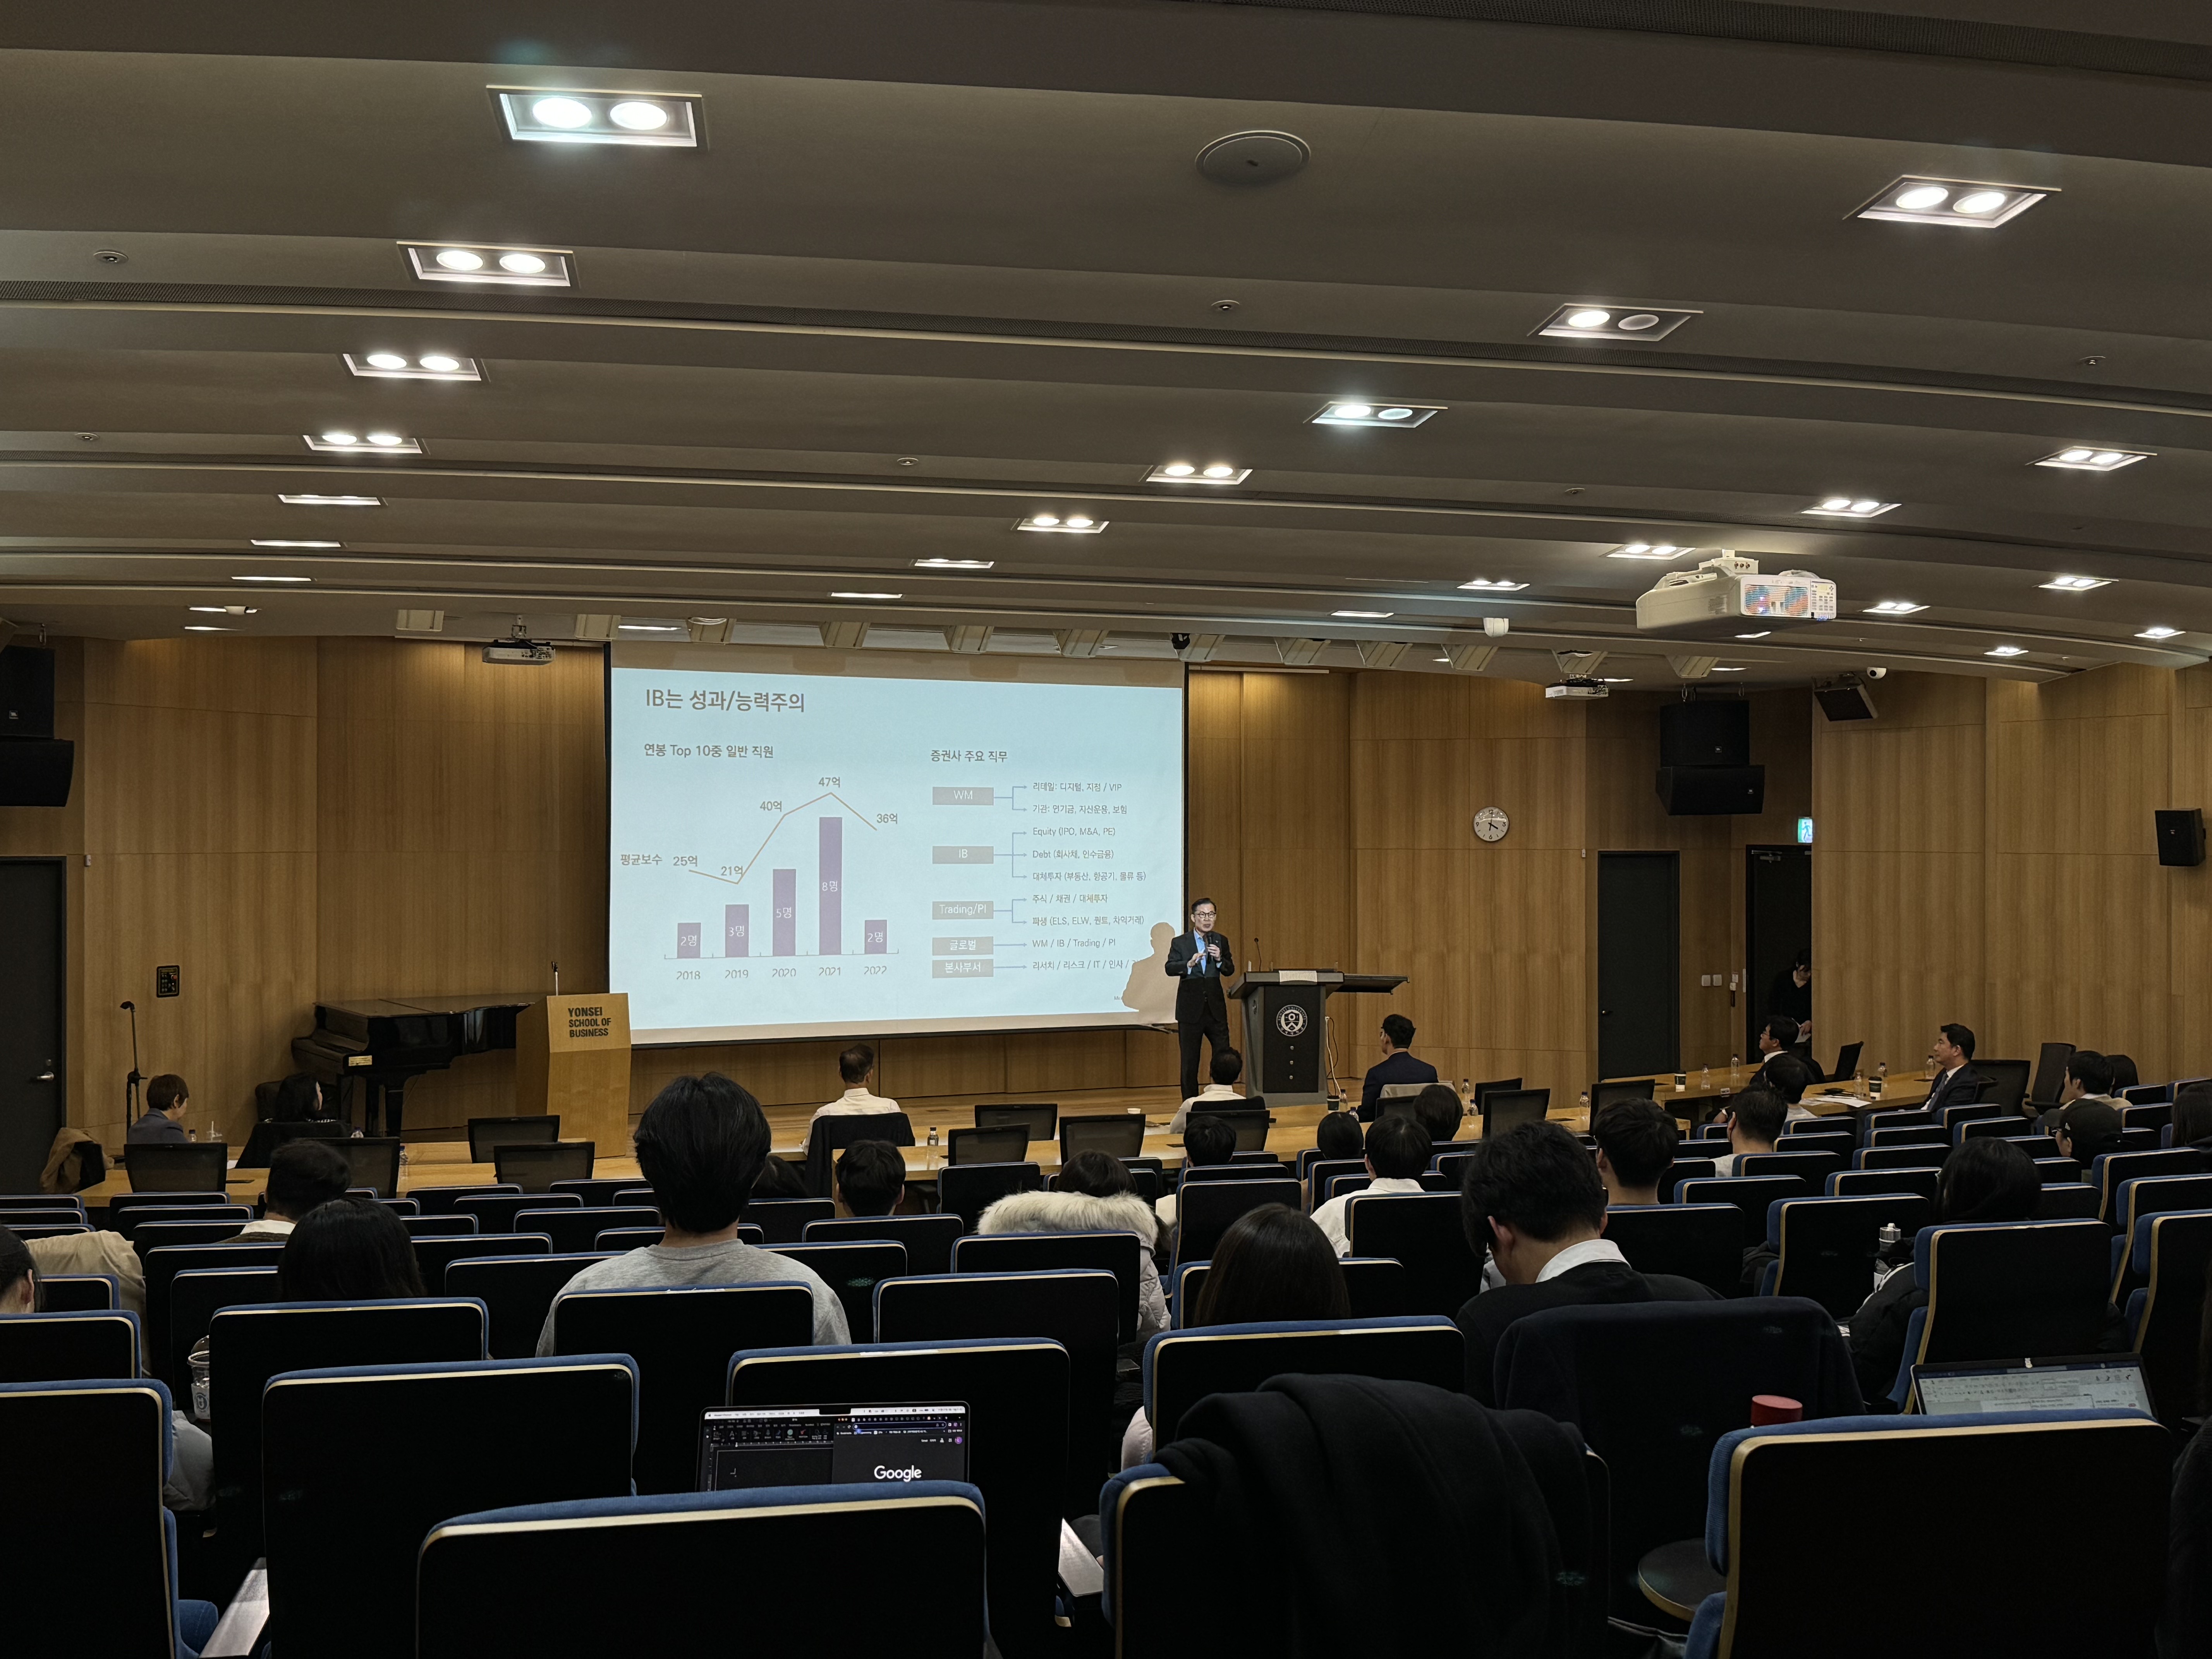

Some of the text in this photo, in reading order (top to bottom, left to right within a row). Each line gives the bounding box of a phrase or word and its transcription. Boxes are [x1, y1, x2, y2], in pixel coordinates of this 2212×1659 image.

[646, 689, 805, 712] IB는 성과/능력주의
[644, 744, 774, 758] 연봉 Top 10중 일반 직원
[931, 750, 1008, 763] 증권사 주요 직무
[819, 777, 841, 788] 47억
[1033, 782, 1057, 792] 리테일:
[1060, 782, 1084, 792] 디지털,
[1086, 783, 1101, 792] 지점
[1109, 783, 1122, 792] VIP
[953, 790, 973, 800] WM
[760, 801, 782, 812] 40억
[1033, 805, 1050, 814] 기관:
[1113, 805, 1127, 814] 보험
[877, 813, 898, 824] 36억
[1033, 827, 1116, 836] Equity (IPO, M&A, PE)
[959, 849, 968, 858] IB
[1033, 849, 1114, 859] Debt (회사채, 인수금융)
[620, 854, 663, 866] 평균보수
[673, 856, 698, 867] 25억
[721, 866, 743, 877] 21억
[1033, 871, 1146, 881] 대체투자 (부동산, 항공기, 물류 등)
[822, 880, 838, 892] 8명
[1032, 894, 1047, 903] 주식
[1056, 894, 1070, 903] 채권
[1080, 894, 1108, 903] 대체투자
[776, 907, 792, 919] 5명
[939, 903, 986, 915] Trading/PI
[1032, 917, 1047, 926] 파생
[1050, 916, 1069, 926] (ELS,
[1072, 917, 1092, 926] ELW,
[728, 925, 745, 937] 3명
[680, 934, 697, 946] 2명
[867, 931, 883, 943] 2명
[950, 939, 976, 950] 글로벌
[1032, 939, 1048, 948] WM
[1073, 939, 1100, 948] Trading
[945, 962, 981, 973] 본사부서
[1033, 961, 1054, 970] 리서치
[1063, 961, 1085, 970] 리스크
[1109, 960, 1123, 969] 인사
[677, 966, 887, 980] 2018 2019 2020 2021 2022
[568, 1006, 603, 1017] YONSEI
[569, 1018, 611, 1027] SCHOOL OF
[570, 1028, 608, 1037] BUSINESS
[874, 1465, 922, 1482] Google
